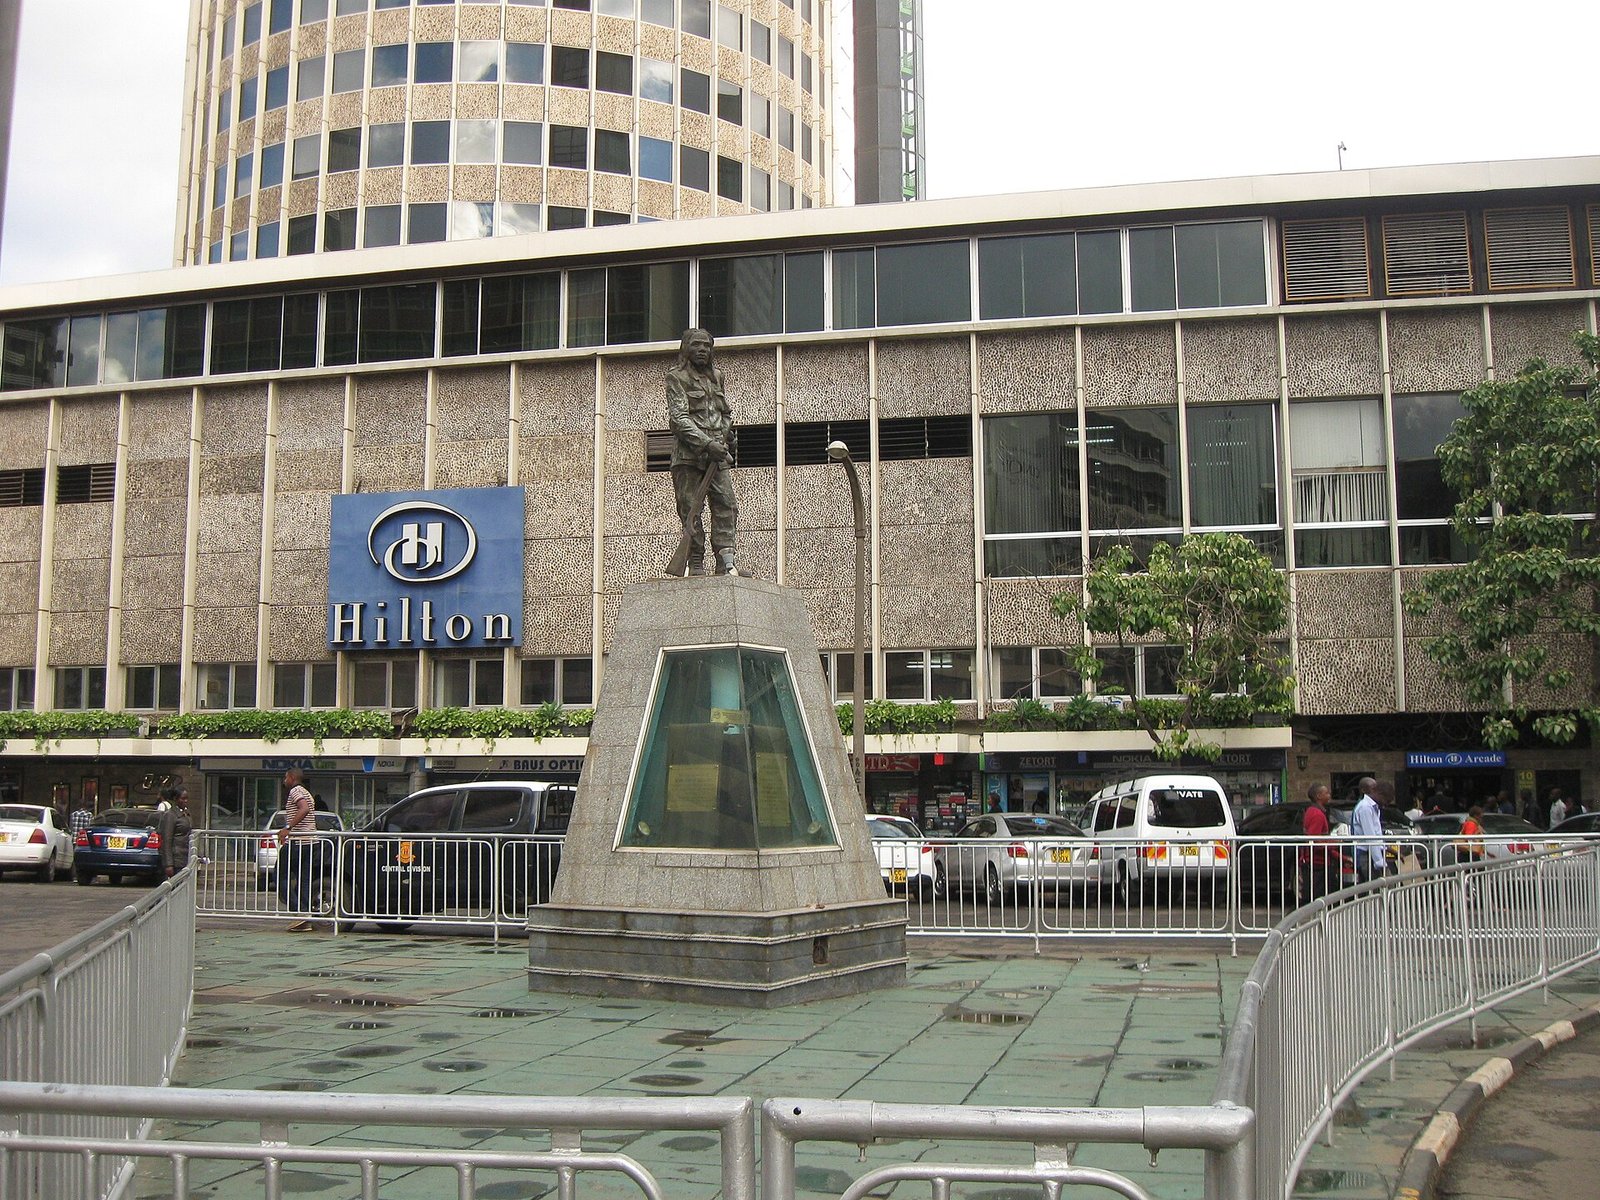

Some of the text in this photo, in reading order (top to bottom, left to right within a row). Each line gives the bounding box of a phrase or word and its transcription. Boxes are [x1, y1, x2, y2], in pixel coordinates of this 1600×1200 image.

[330, 597, 513, 644] Hilton
[262, 759, 313, 769] NOKIA
[1019, 757, 1056, 765] ZETORT
[1112, 755, 1152, 763] NOKIA
[1410, 755, 1443, 764] Hilton
[1464, 754, 1502, 763] Arcade
[514, 760, 544, 770] BAUS
[406, 865, 431, 873] DVISON
